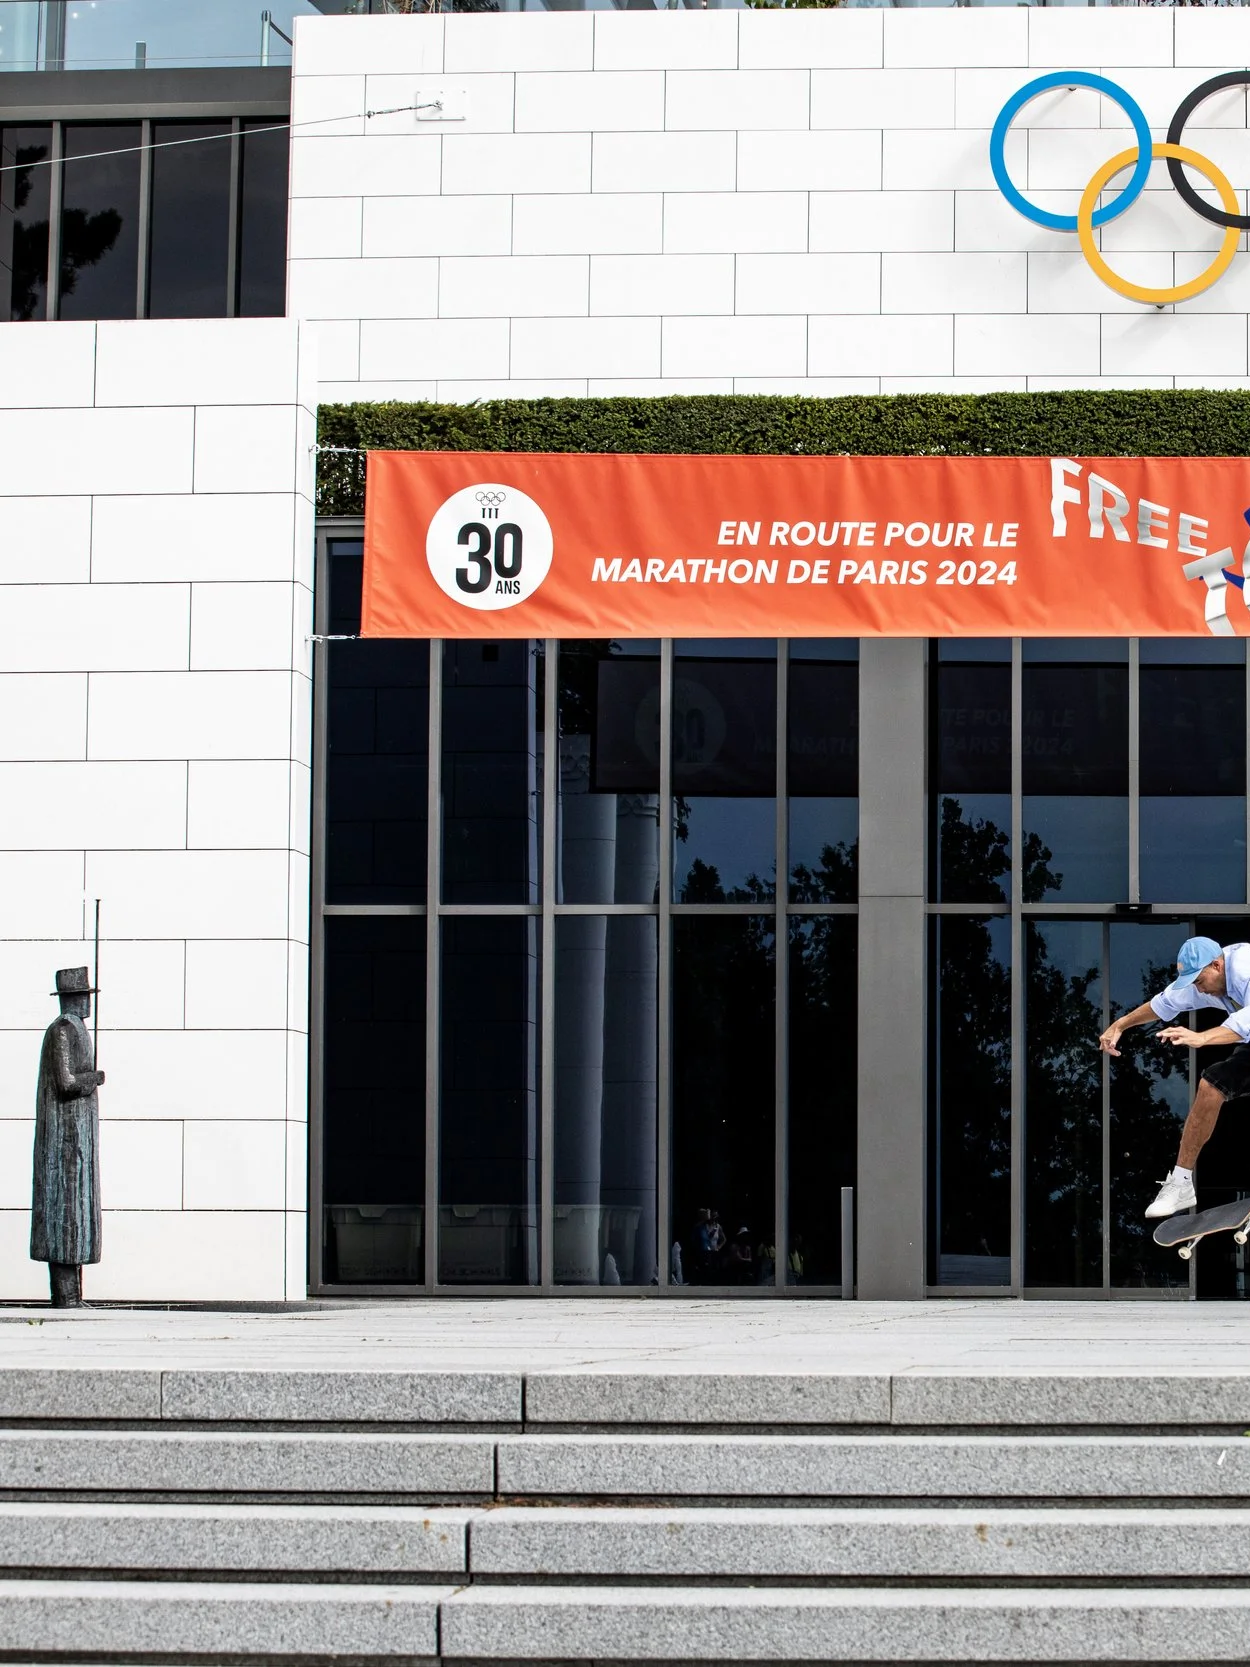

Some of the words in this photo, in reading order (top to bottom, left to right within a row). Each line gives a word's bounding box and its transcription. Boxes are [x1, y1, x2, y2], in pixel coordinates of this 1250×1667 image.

[1050, 457, 1209, 557] FREE
[717, 521, 761, 546] EN
[769, 521, 877, 547] ROUTE
[884, 521, 975, 547] POUR
[982, 522, 1019, 547] LE
[455, 521, 523, 594] 30
[591, 557, 779, 584] MARATHON
[786, 559, 831, 584] DE
[837, 559, 929, 585] PARIS
[935, 560, 1018, 586] 2024
[495, 580, 521, 595] ANS
